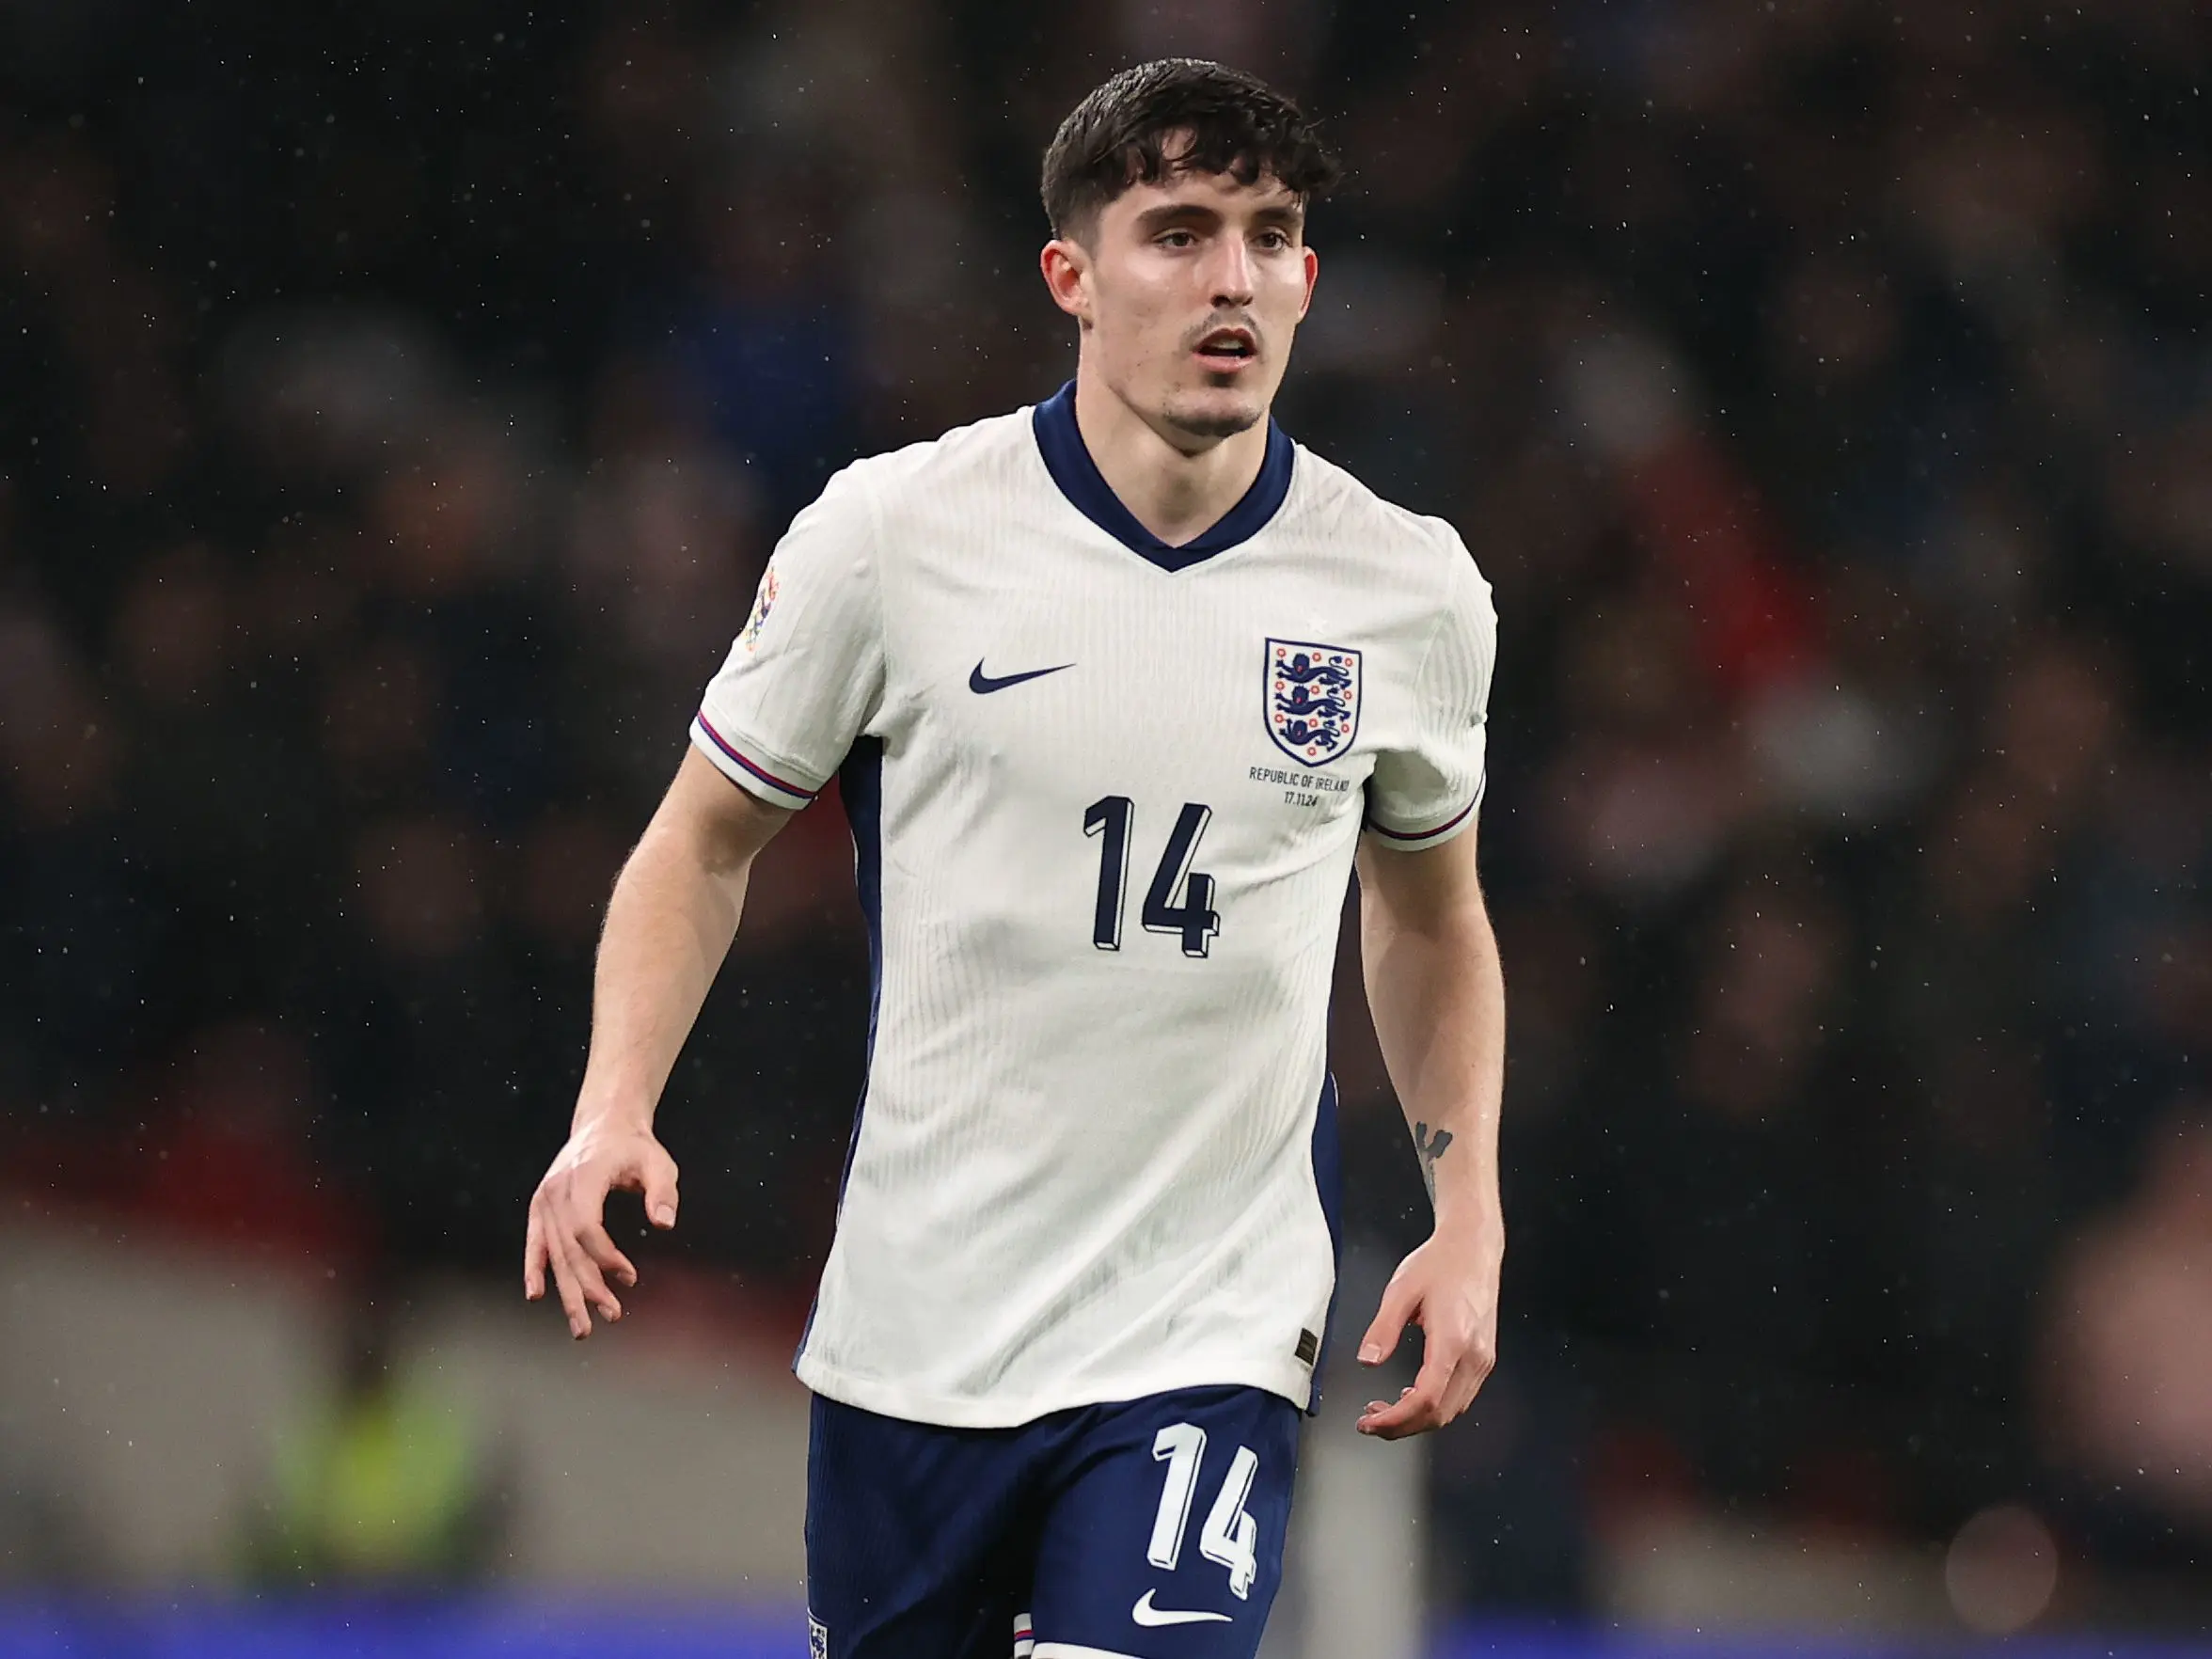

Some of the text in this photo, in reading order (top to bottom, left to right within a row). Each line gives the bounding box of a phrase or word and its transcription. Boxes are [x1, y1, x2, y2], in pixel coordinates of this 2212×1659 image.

[1249, 766, 1299, 786] REPUBLIC
[1301, 774, 1314, 788] OF
[1083, 795, 1221, 958] 14
[1146, 1422, 1258, 1601] 14
